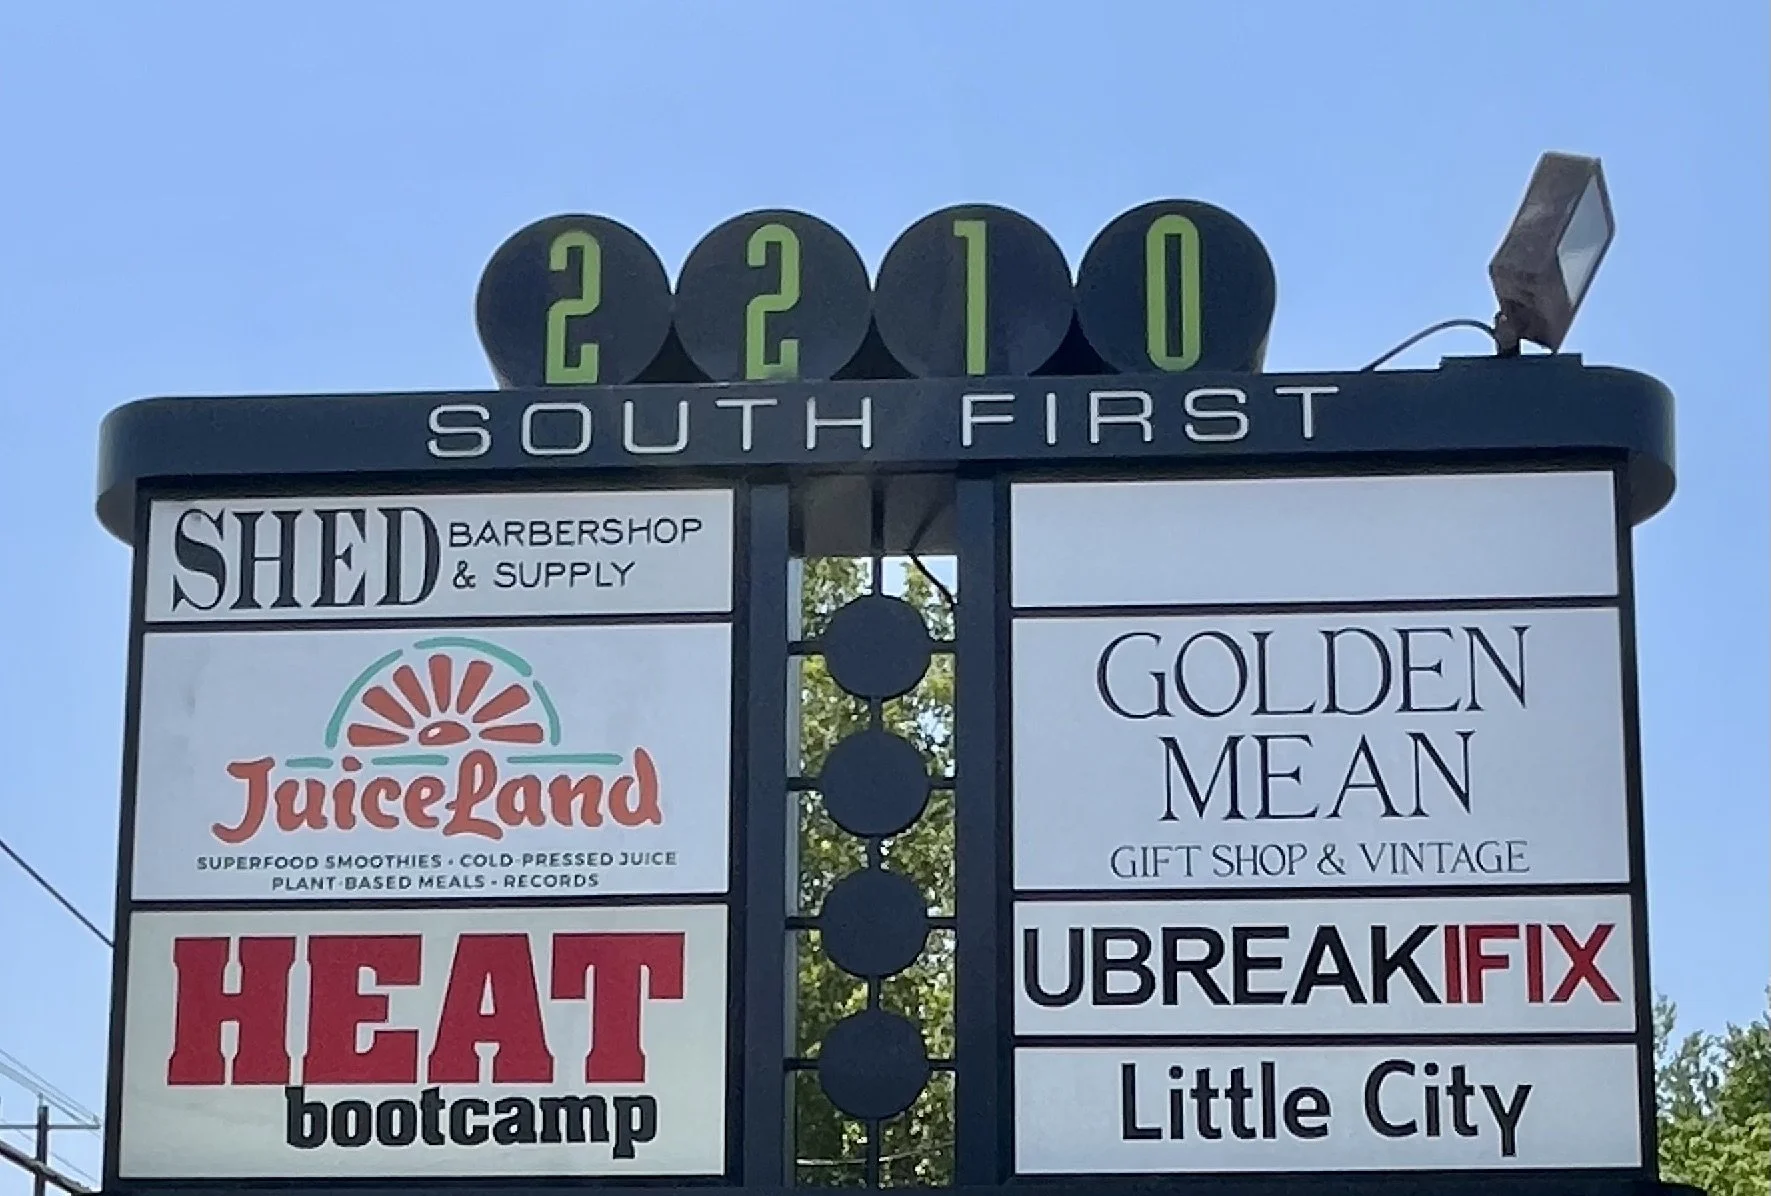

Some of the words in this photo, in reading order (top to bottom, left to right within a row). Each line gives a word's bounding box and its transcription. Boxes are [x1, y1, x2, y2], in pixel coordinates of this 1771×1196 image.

[426, 396, 874, 458] SOUTH
[961, 385, 1340, 447] FIRST
[172, 506, 442, 612] SHED
[448, 517, 704, 549] BARBERSHOP
[452, 559, 477, 590] &
[492, 560, 636, 589] SUPPLY
[1096, 624, 1532, 720] GOLDEN
[211, 746, 662, 844] JuiceLand
[1157, 729, 1476, 822] MEAN
[196, 855, 320, 871] SUPERFOOD
[324, 854, 442, 870] SMOOTHIES
[619, 851, 677, 866] JUICE
[418, 874, 485, 890] MEALS
[503, 873, 599, 888] RECORDS
[1110, 844, 1202, 879] GIFT
[1211, 842, 1308, 878] SHOP
[1316, 843, 1347, 876] &
[1358, 840, 1531, 875] VINTAGE
[1022, 922, 1622, 1008] UBREAKIFIX
[167, 933, 685, 1085] HEAT
[284, 1086, 659, 1160] bootcamp
[1120, 1060, 1332, 1141] Little
[1364, 1058, 1533, 1158] City
